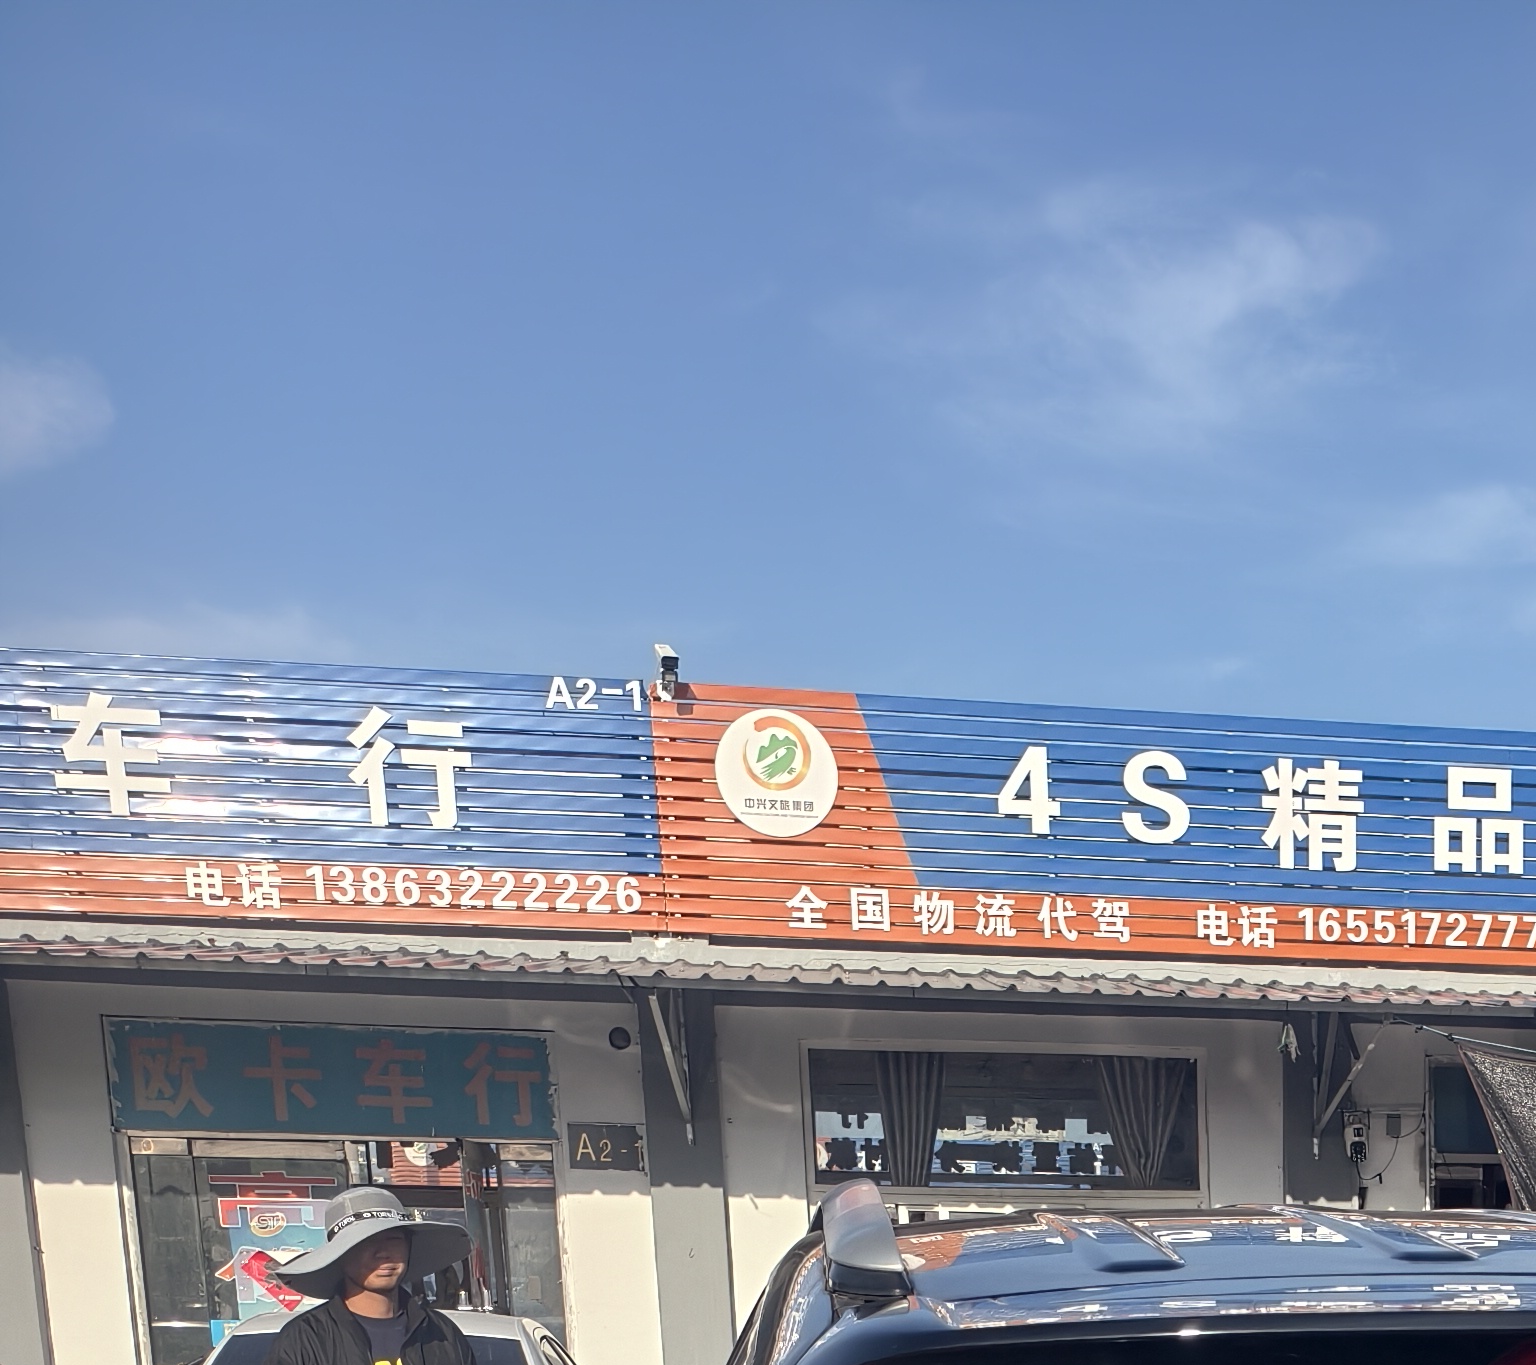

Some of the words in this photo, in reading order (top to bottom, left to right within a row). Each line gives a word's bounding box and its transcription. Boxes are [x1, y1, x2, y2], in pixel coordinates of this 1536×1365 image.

[545, 676, 643, 712] A2-1
[50, 692, 472, 830] 车行
[185, 862, 281, 909] 电话
[305, 865, 643, 914] 13863222226
[785, 885, 1130, 943] 全国物流代驾
[1196, 904, 1278, 949] 电话
[128, 1035, 543, 1127] 欧卡车行
